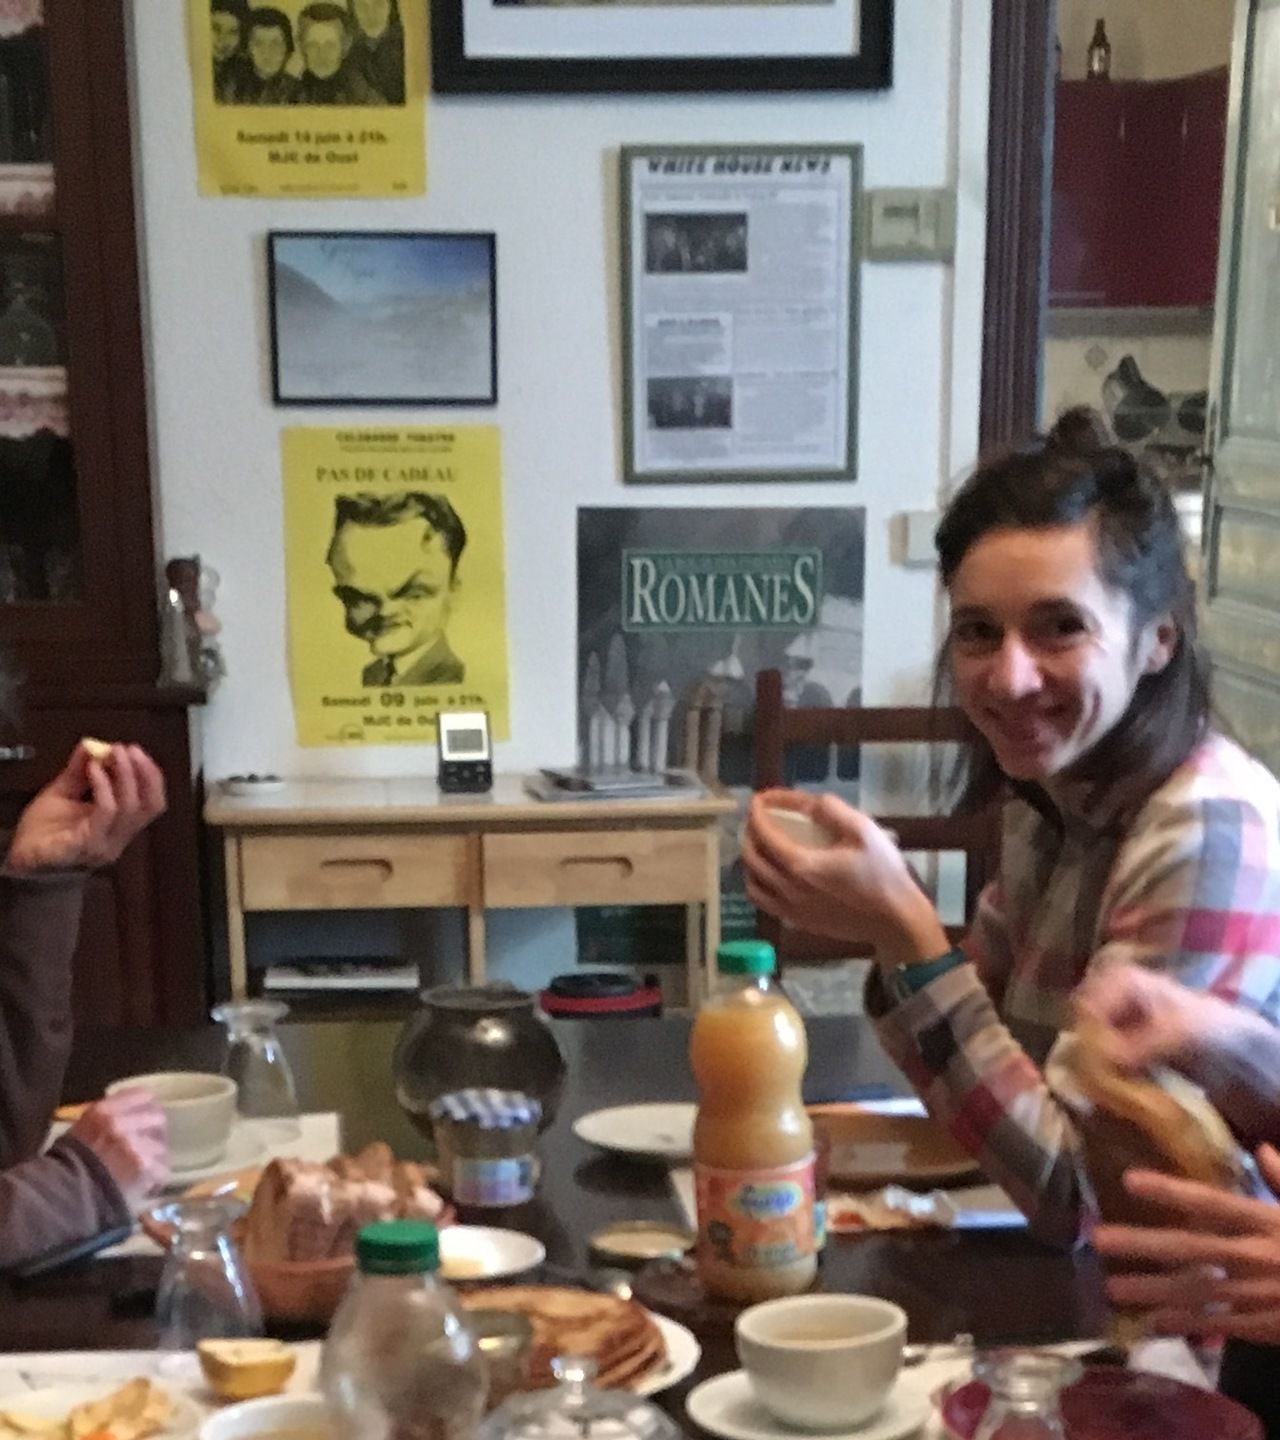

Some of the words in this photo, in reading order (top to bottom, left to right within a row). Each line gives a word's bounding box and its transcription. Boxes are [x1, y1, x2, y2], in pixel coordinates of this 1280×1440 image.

[648, 156, 706, 174] WHITE
[713, 156, 773, 174] HOUSE
[780, 156, 832, 174] NEWS
[316, 466, 349, 482] PAS
[354, 466, 376, 482] DE
[382, 466, 457, 482] CADEAU
[322, 695, 372, 707] Samedi
[379, 692, 406, 708] 09
